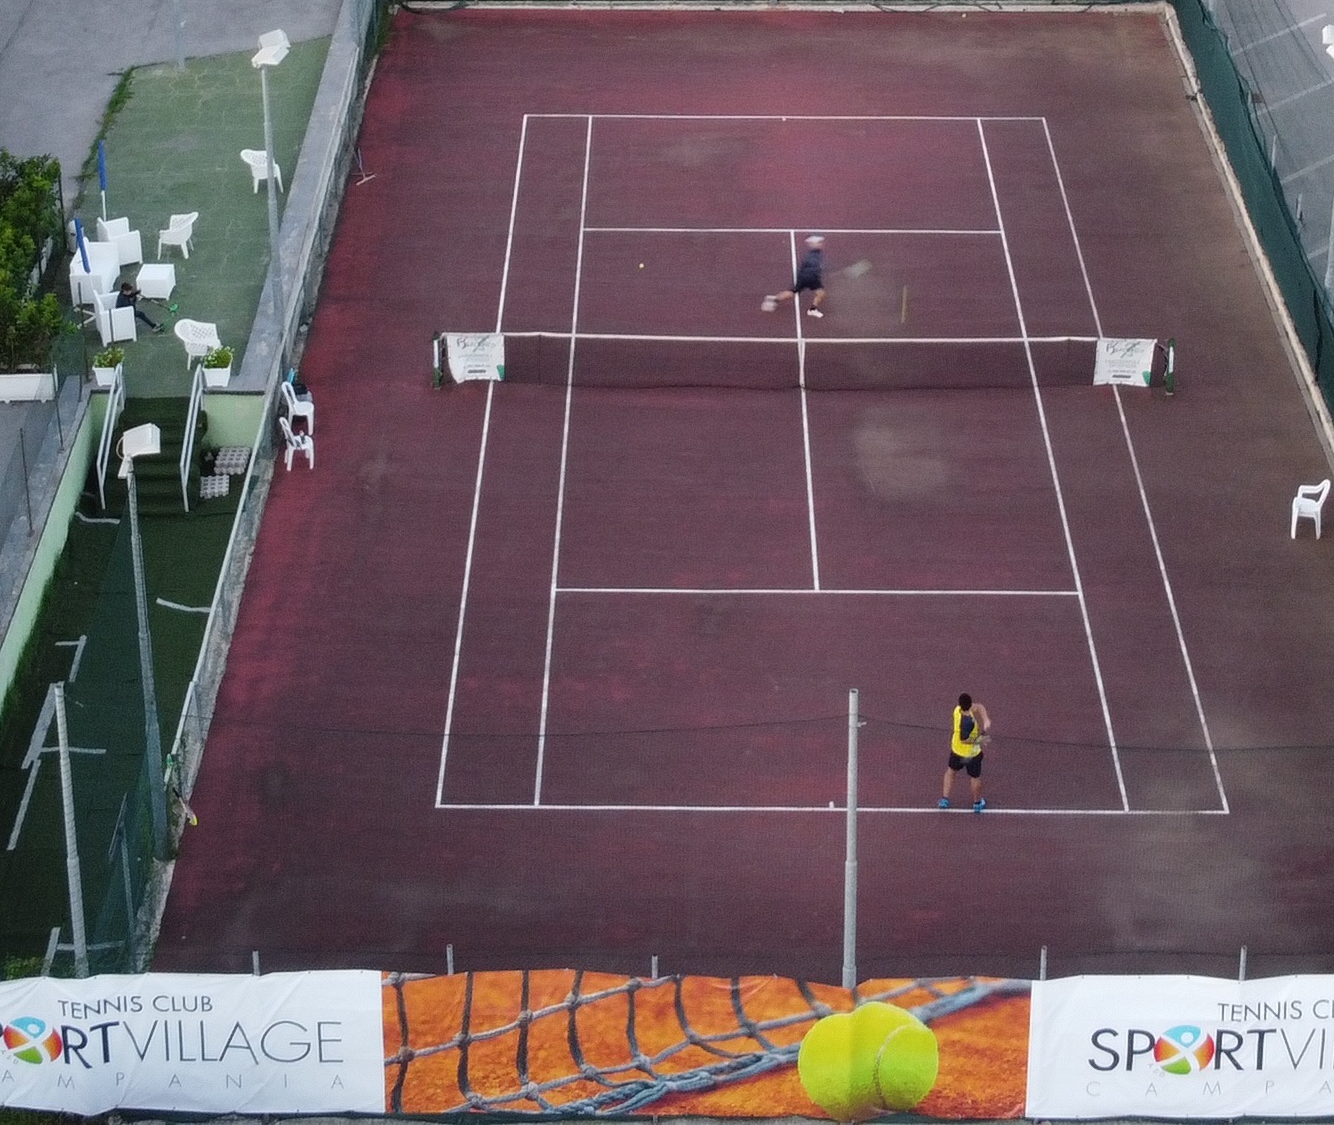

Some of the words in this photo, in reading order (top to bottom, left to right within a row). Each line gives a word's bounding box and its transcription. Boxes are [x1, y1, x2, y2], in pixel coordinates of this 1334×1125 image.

[57, 995, 143, 1020] TENNIS
[152, 994, 214, 1013] CLUB
[1217, 1000, 1303, 1023] TENNIS
